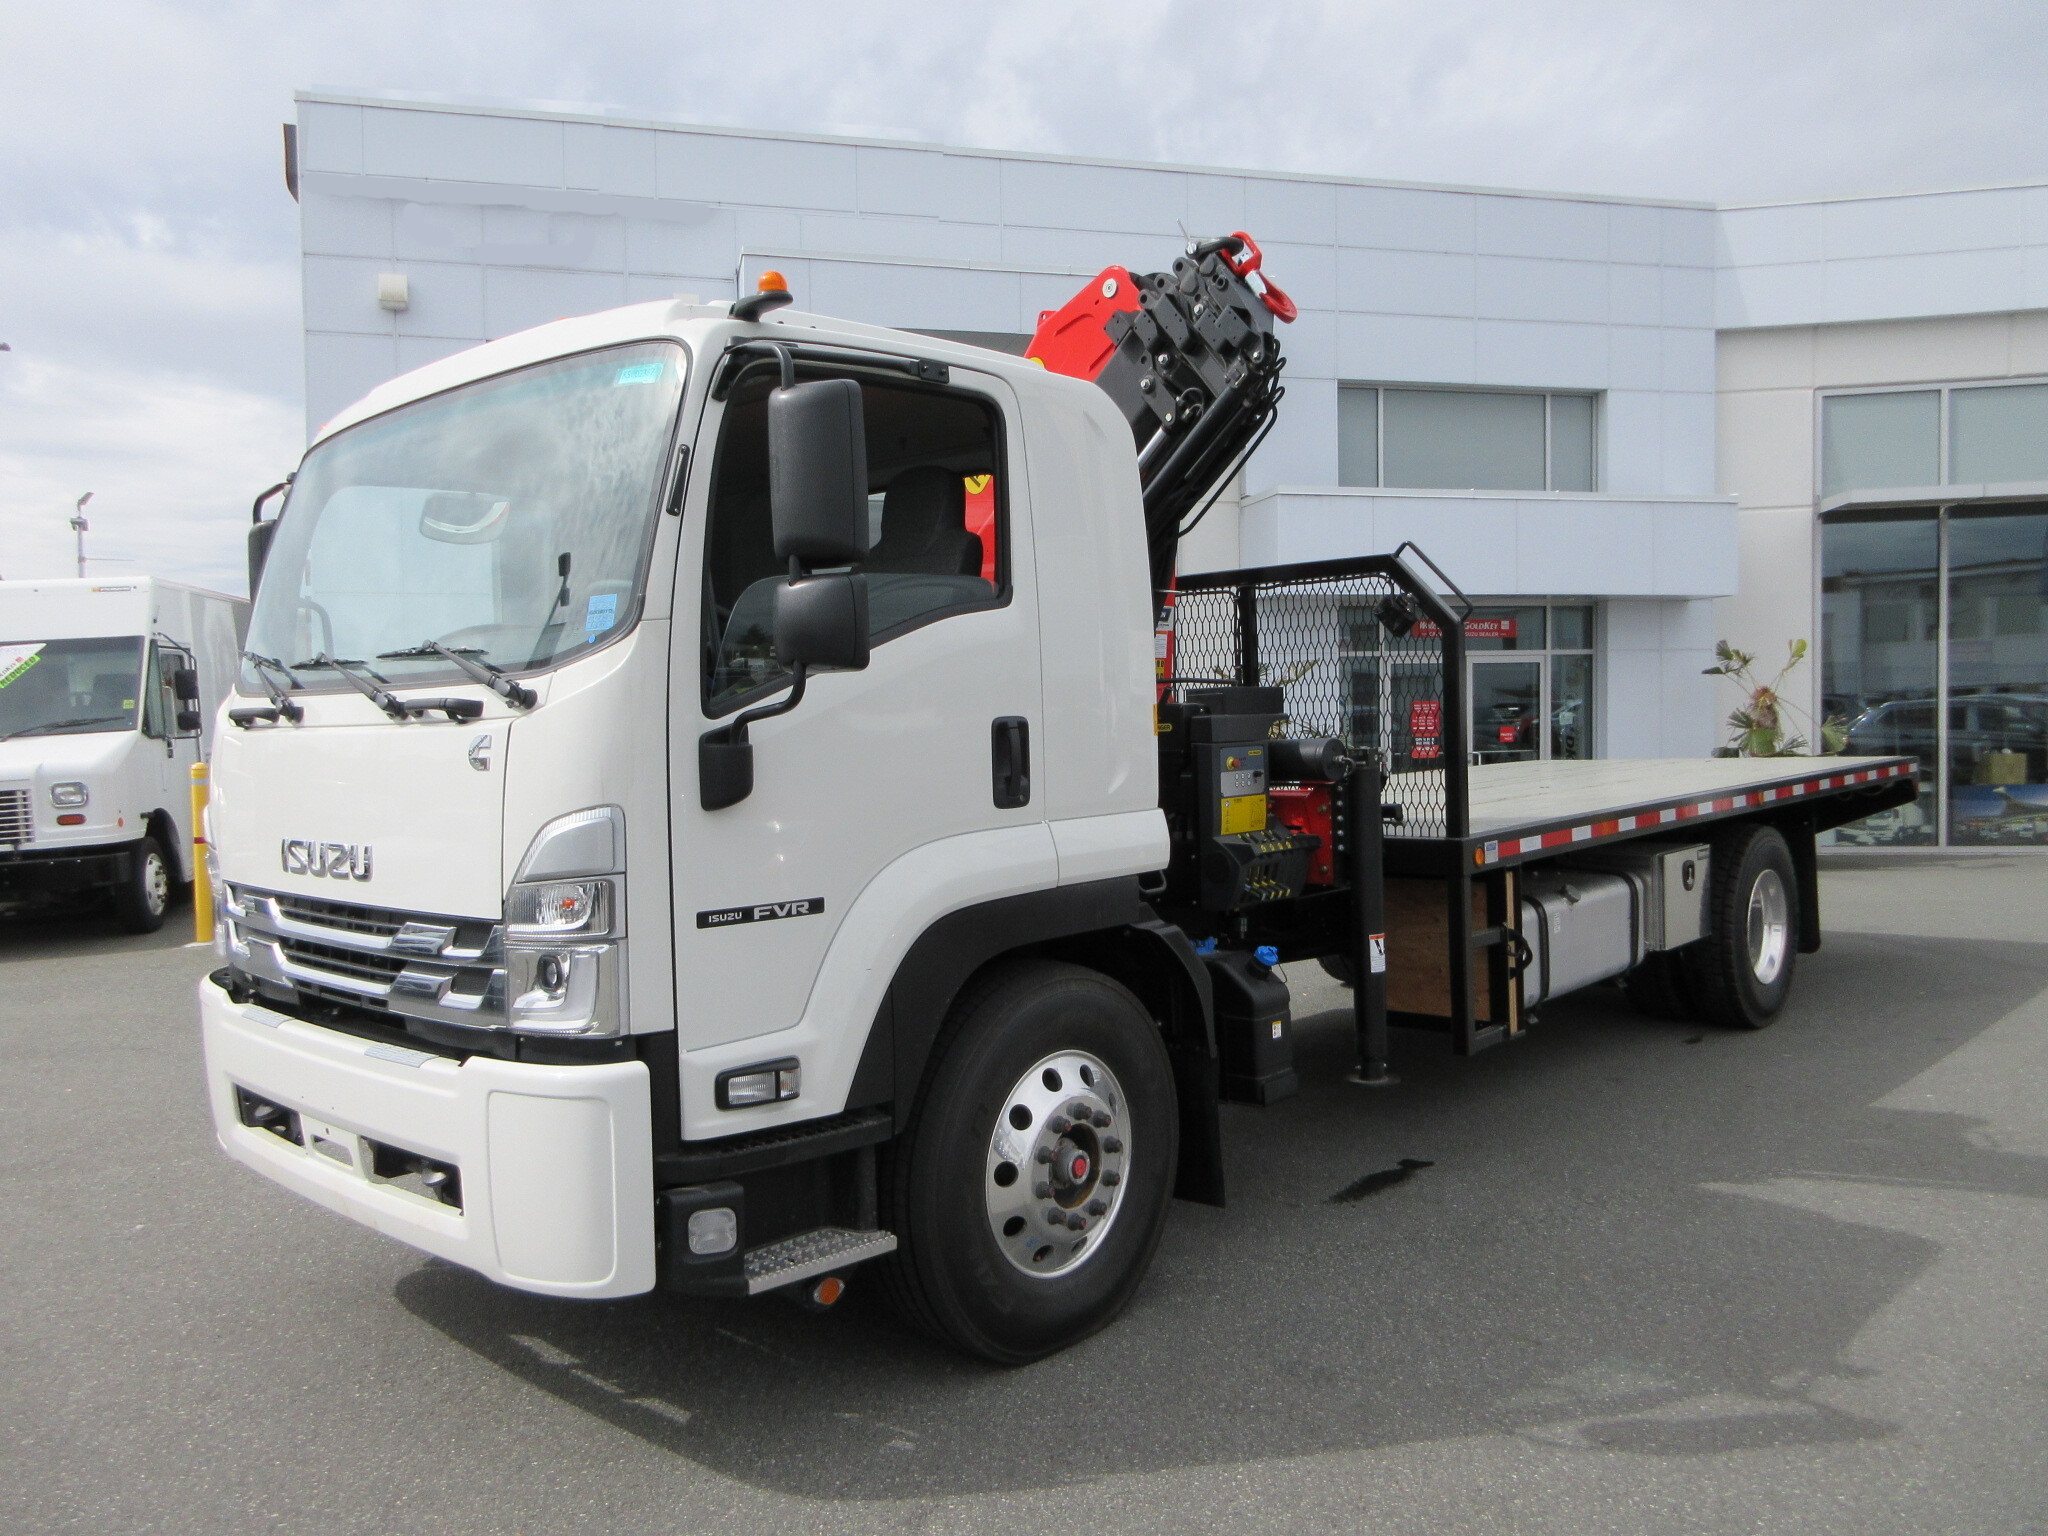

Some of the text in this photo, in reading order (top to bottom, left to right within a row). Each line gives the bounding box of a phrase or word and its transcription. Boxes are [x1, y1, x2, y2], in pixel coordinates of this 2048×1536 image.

[281, 838, 373, 882] ISUZU
[708, 901, 810, 923] ISUZU FVR
